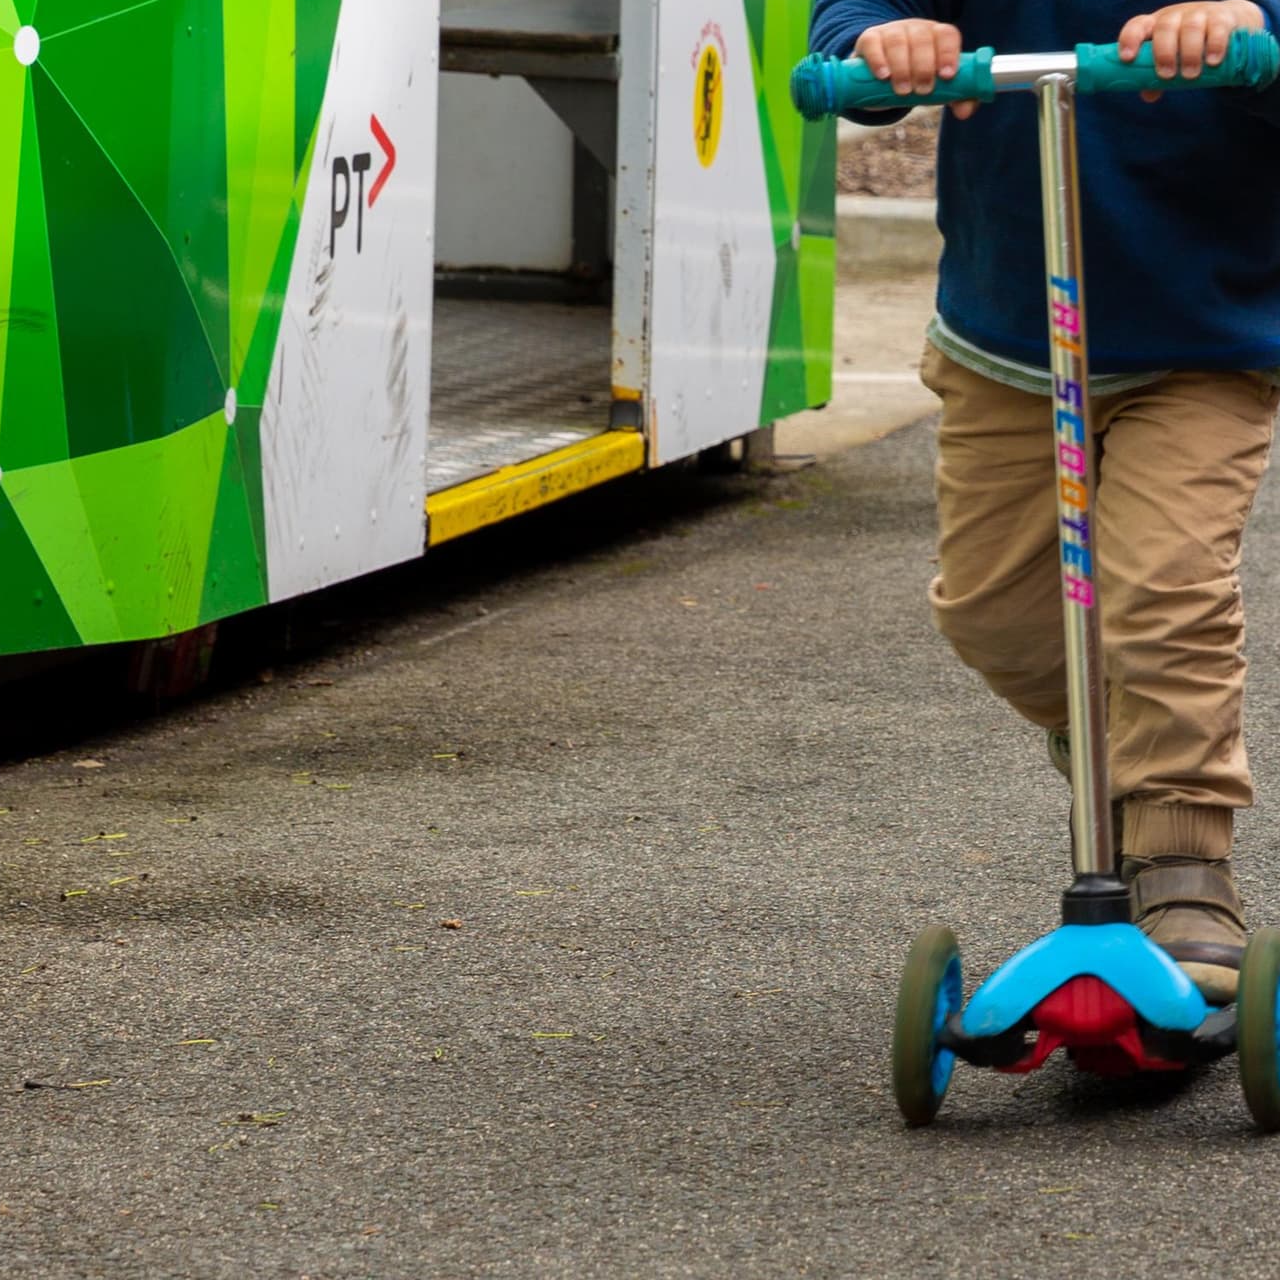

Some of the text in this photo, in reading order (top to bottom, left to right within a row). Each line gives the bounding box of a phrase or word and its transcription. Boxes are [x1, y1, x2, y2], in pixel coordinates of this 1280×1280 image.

[329, 152, 372, 260] PT
[1050, 274, 1095, 609] TRI SCOOTER
